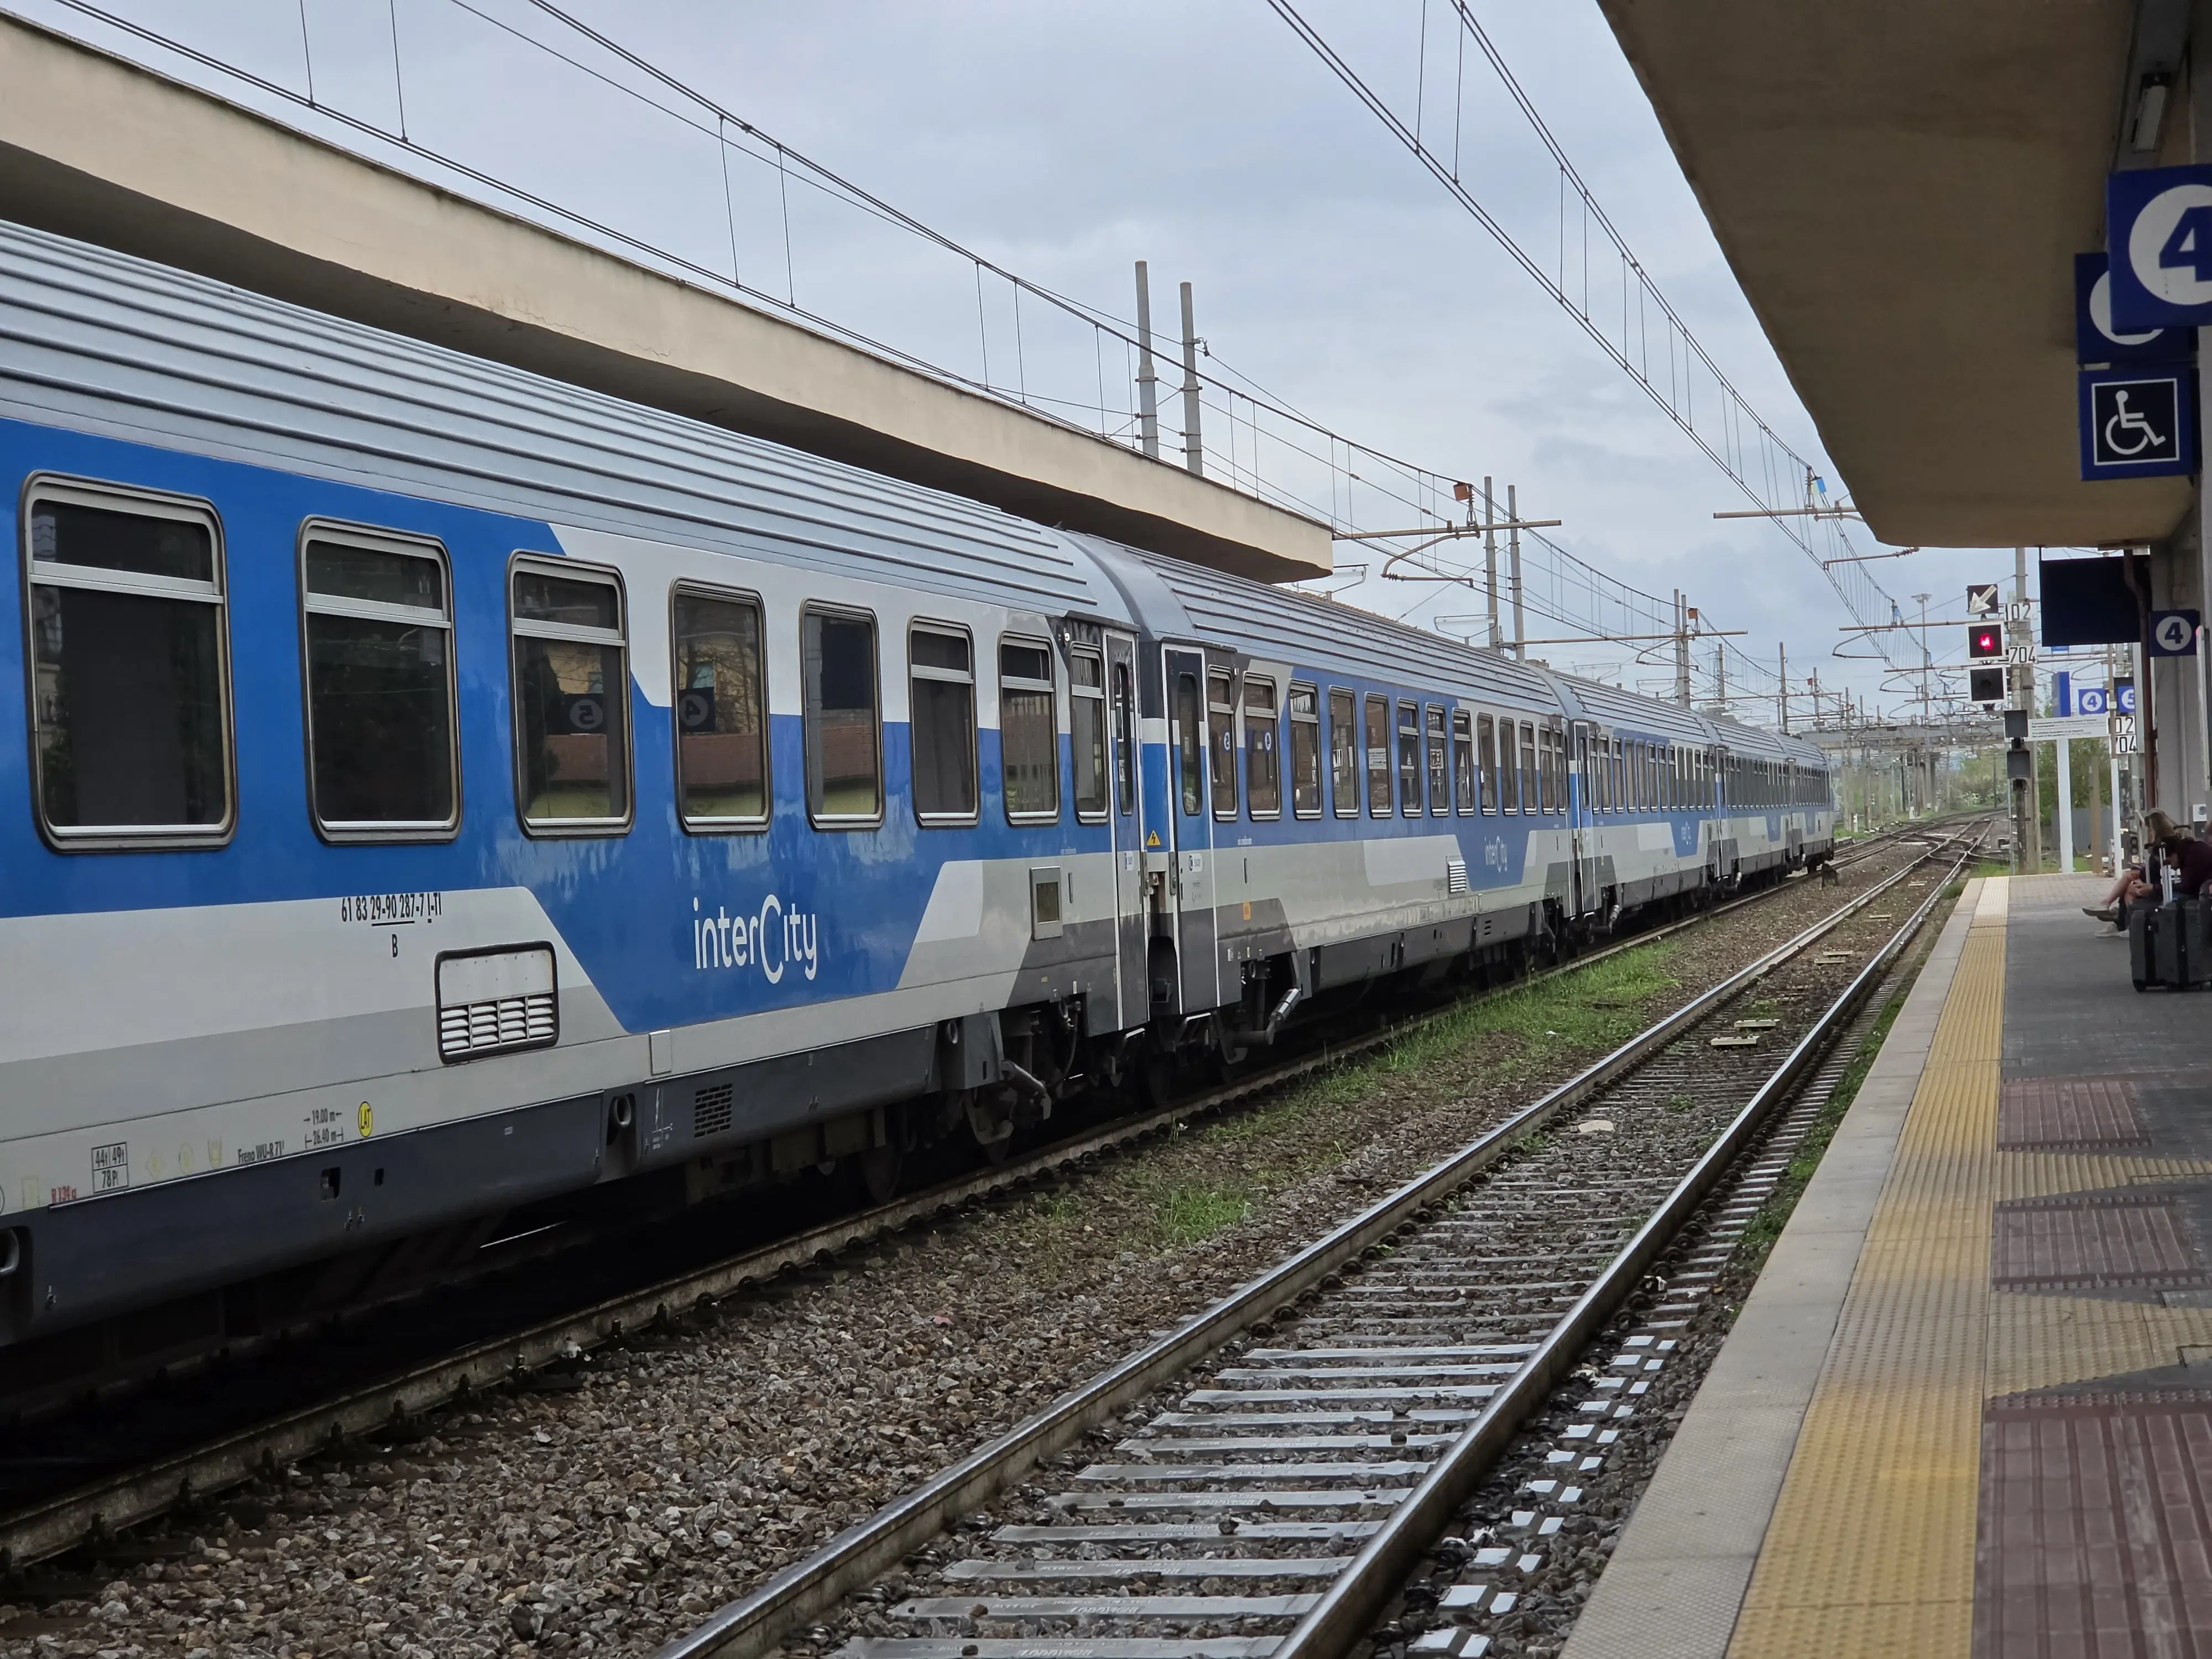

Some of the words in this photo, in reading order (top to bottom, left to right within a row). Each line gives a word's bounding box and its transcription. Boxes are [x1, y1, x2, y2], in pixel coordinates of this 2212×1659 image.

[2159, 205, 2212, 283] 4
[2005, 603, 2031, 620] 102
[2164, 622, 2183, 644] 4
[2010, 646, 2036, 663] 704
[2087, 695, 2098, 708] 4
[341, 897, 352, 922] 61
[356, 895, 368, 921] 83
[370, 894, 397, 920] 29-90
[399, 893, 425, 919] 287-7
[392, 933, 398, 958] B
[693, 894, 817, 984] interCity
[312, 1108, 328, 1125] 19.00
[360, 1108, 370, 1130] LAT
[102, 1170, 112, 1189] 78
